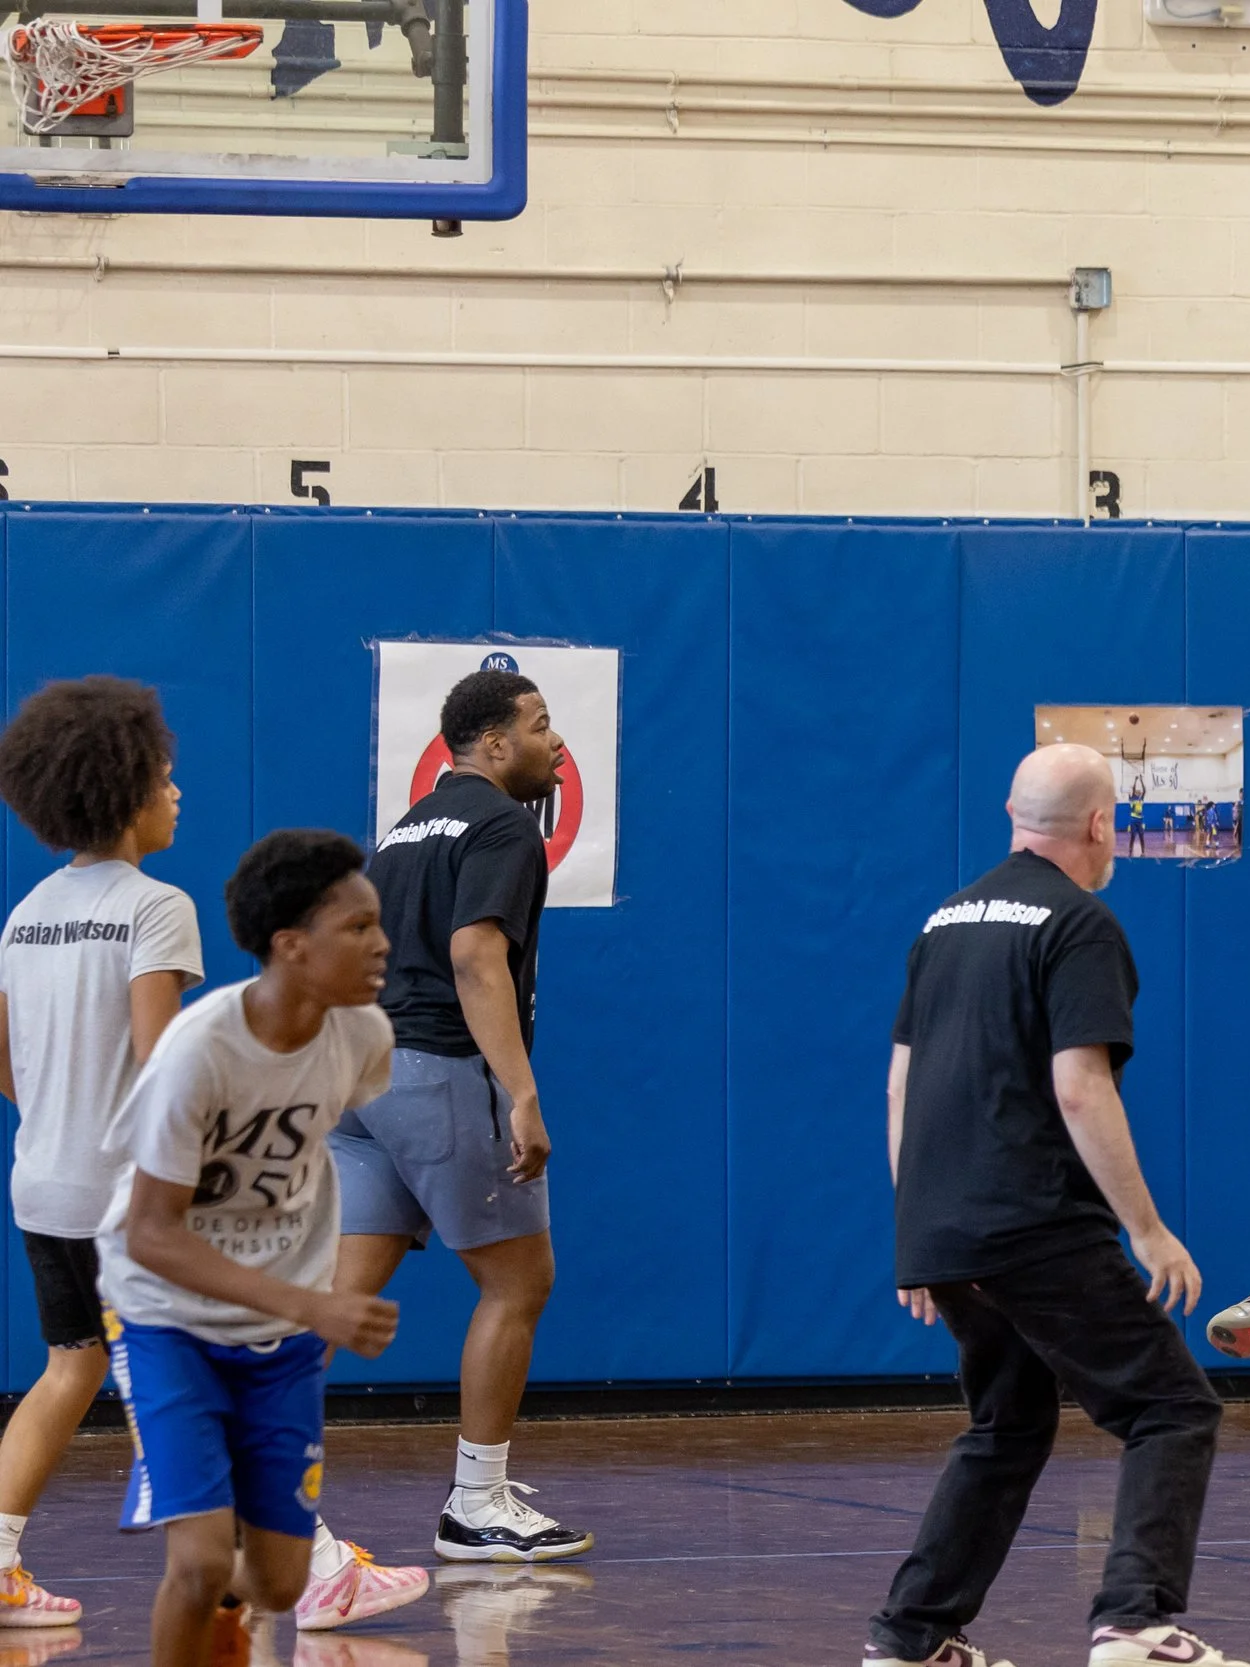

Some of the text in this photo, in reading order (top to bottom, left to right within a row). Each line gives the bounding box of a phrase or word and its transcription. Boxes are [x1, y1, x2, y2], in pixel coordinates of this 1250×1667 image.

[290, 460, 330, 506] 5
[679, 467, 719, 513] 4
[1089, 470, 1120, 519] 3
[487, 657, 508, 669] MS
[63, 919, 130, 945] Watson
[983, 899, 1052, 926] Watson
[203, 1103, 320, 1161] MS
